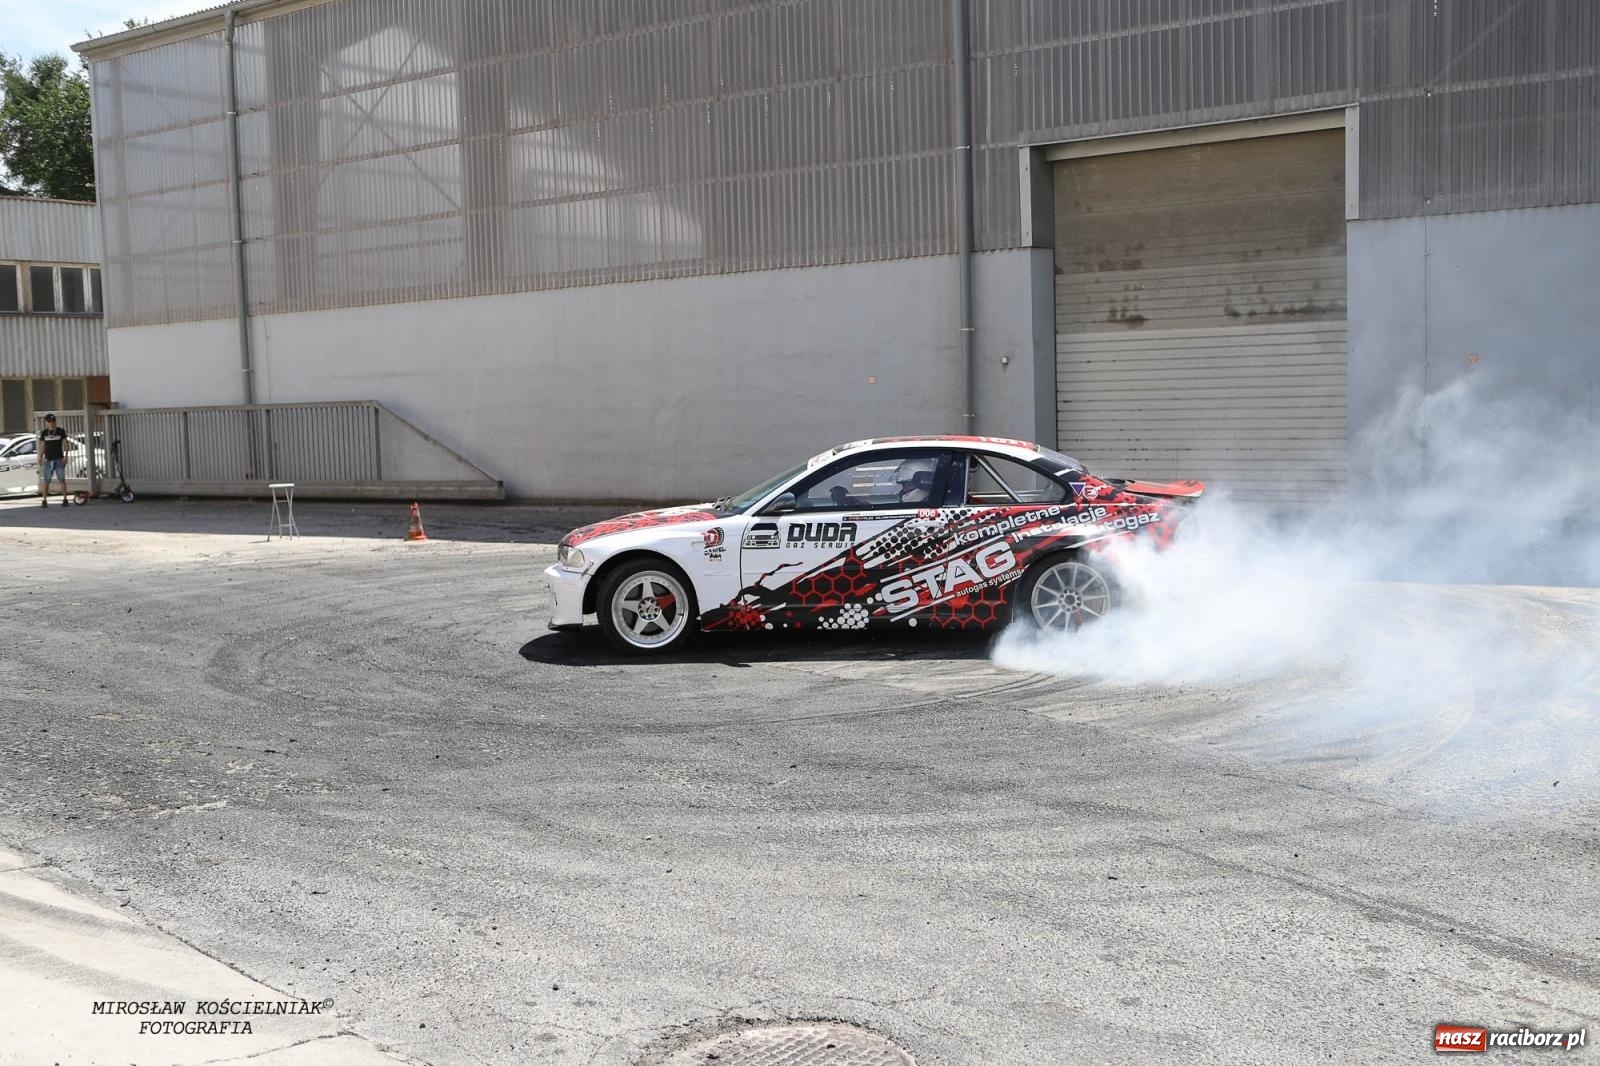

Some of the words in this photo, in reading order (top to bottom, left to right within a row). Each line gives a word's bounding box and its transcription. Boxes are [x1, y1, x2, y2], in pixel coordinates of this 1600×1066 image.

[919, 508, 936, 517] 006
[954, 505, 1061, 546] kompletne
[787, 522, 858, 542] DUDA
[880, 540, 1017, 614] STAG
[956, 580, 988, 598] autogas
[989, 568, 1025, 587] systems
